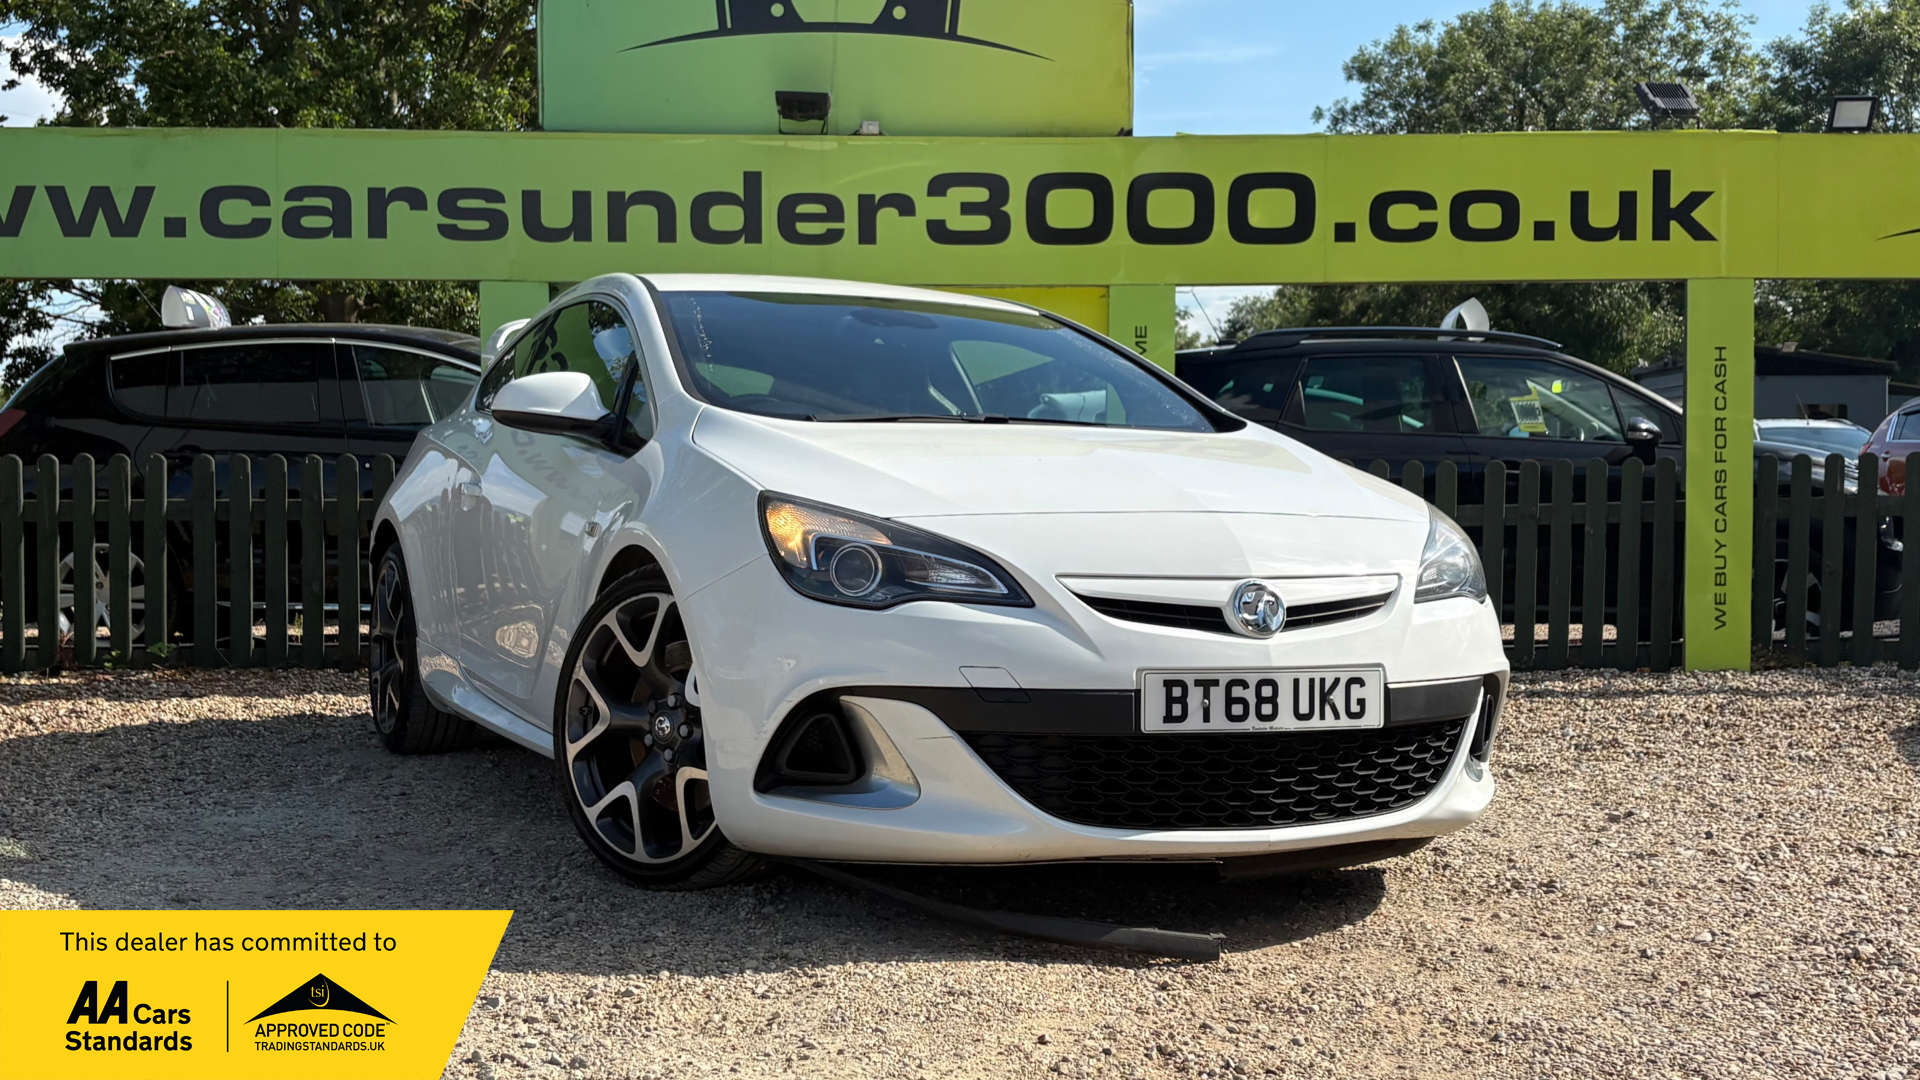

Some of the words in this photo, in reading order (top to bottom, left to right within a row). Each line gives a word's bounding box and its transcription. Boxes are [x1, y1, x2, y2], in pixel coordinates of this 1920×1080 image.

[1713, 346, 1728, 412] CASH
[1713, 416, 1728, 464] FOR
[1713, 468, 1728, 534] CARS
[1713, 539, 1728, 588] BUY
[1713, 592, 1728, 631] WE
[1162, 677, 1279, 724] BT68
[1292, 676, 1366, 722] UKG
